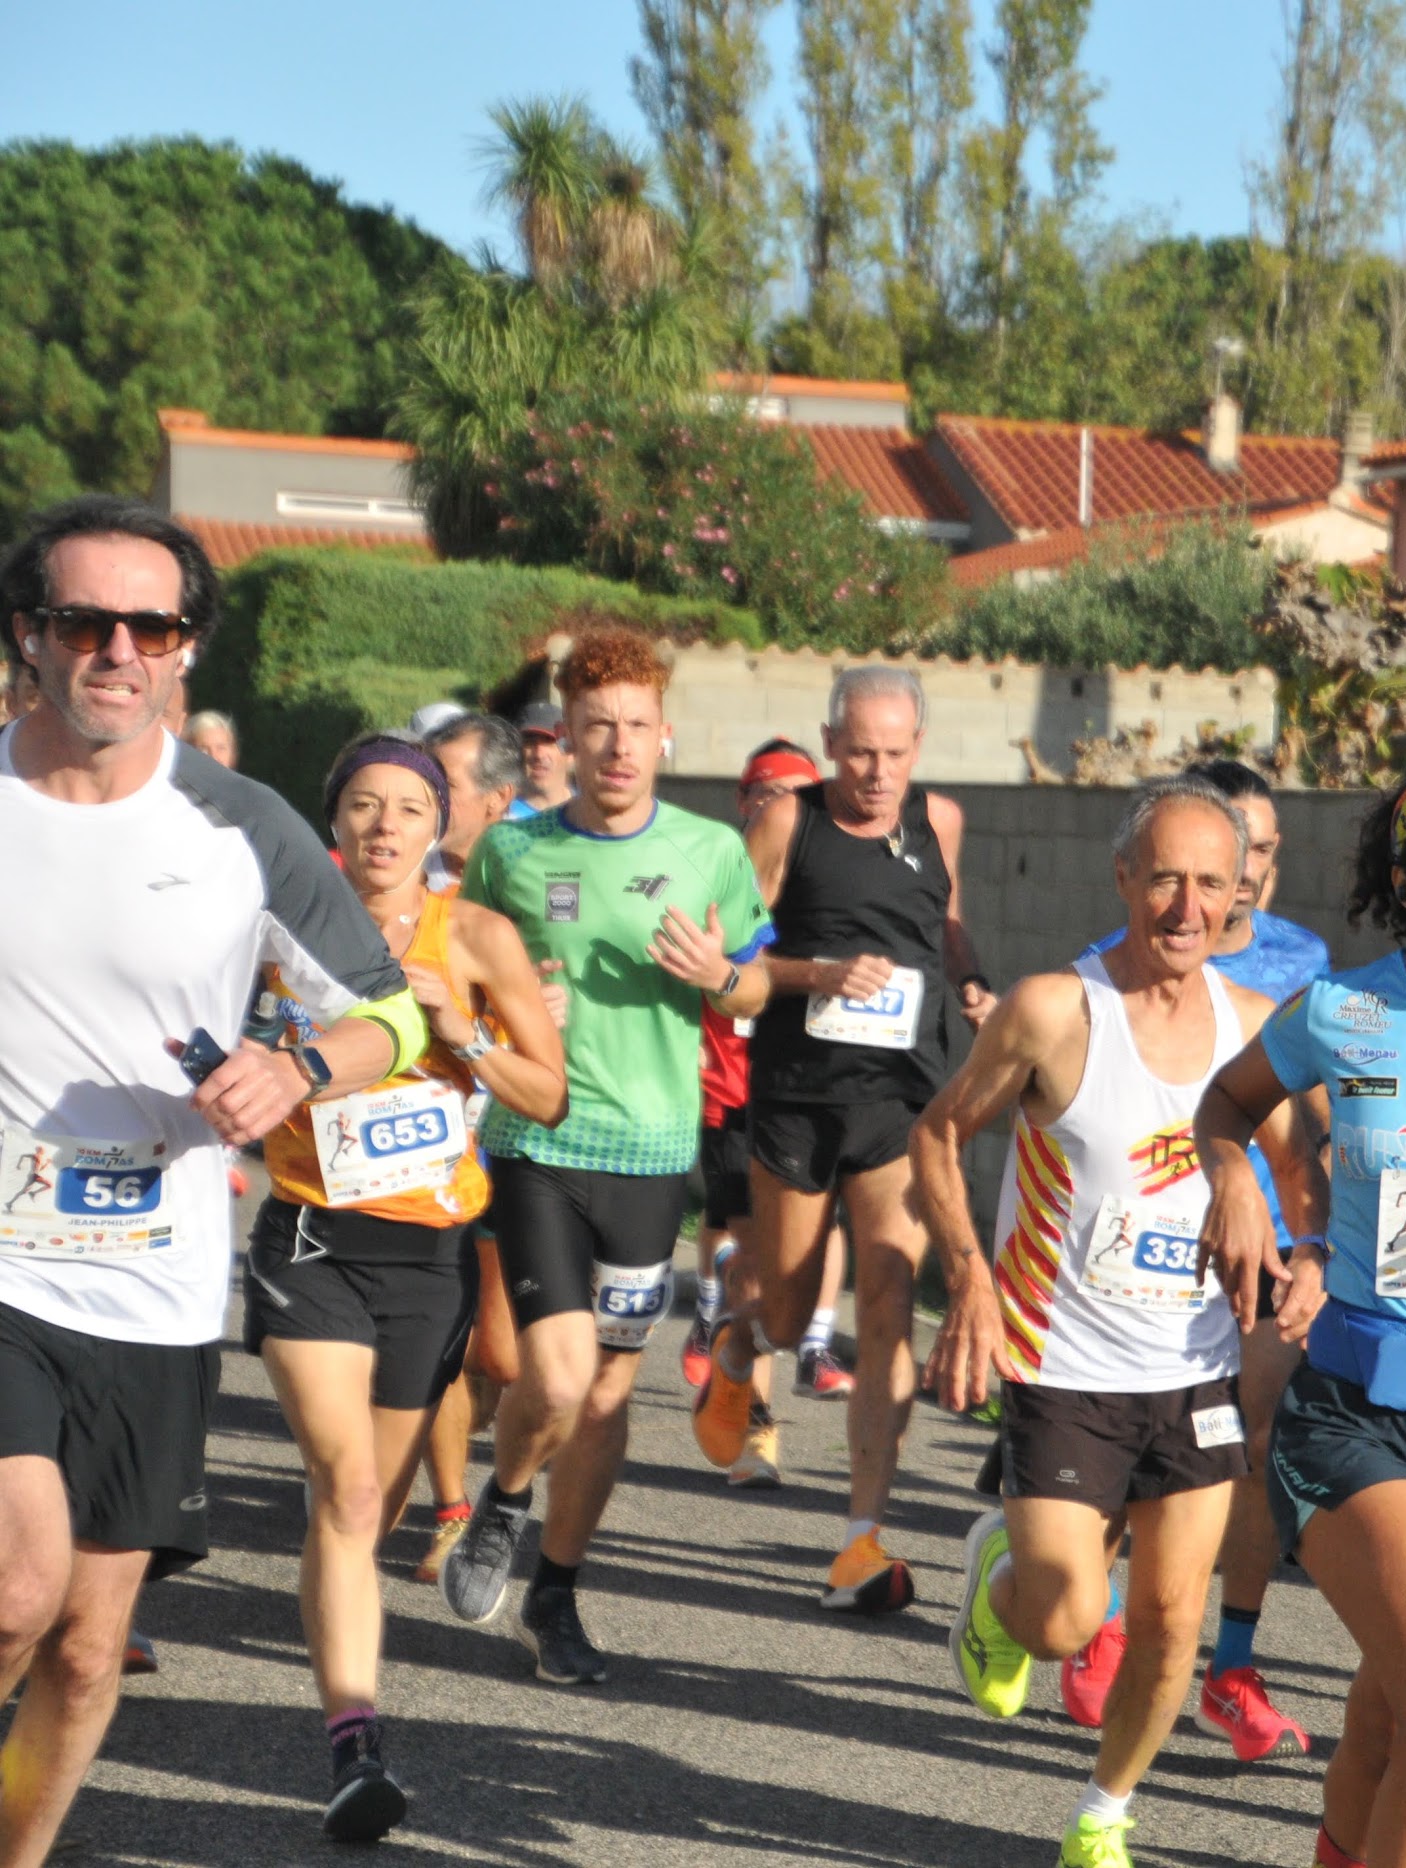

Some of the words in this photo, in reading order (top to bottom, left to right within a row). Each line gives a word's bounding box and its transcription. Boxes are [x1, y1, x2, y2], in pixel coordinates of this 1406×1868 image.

[370, 1113, 440, 1151] 653
[83, 1175, 142, 1208] 56
[68, 1217, 147, 1227] JEAN-PHILIPPE
[607, 1289, 661, 1313] 515
